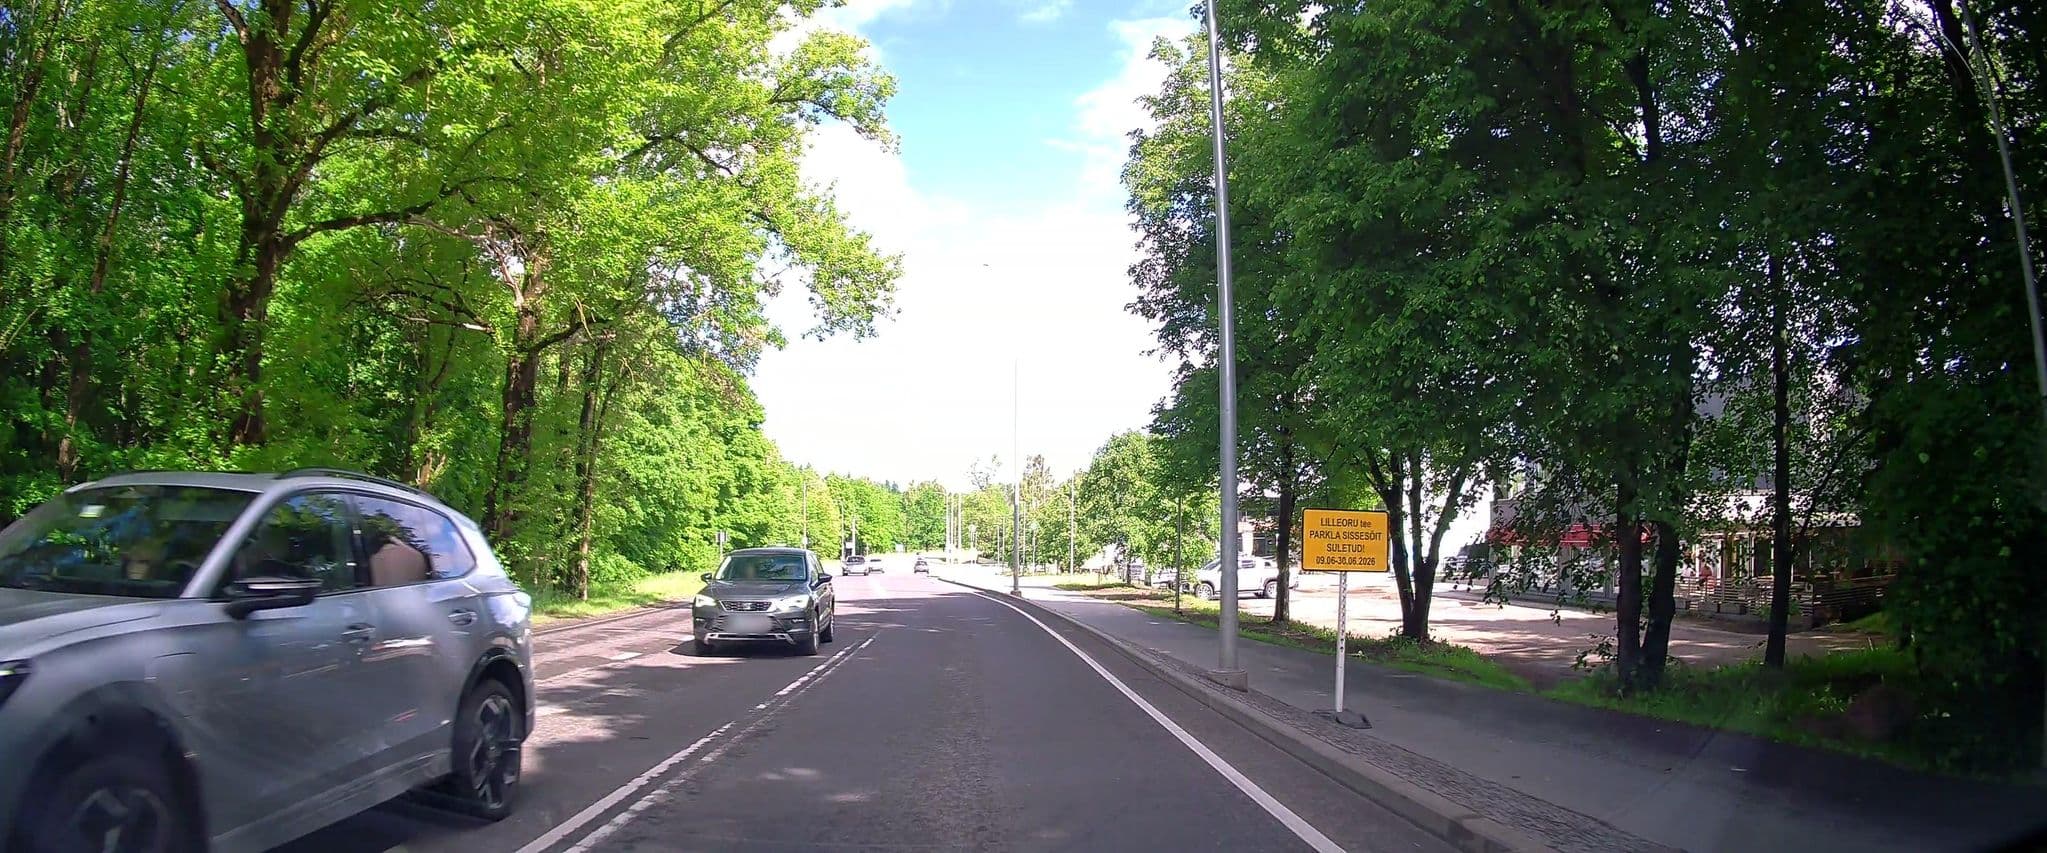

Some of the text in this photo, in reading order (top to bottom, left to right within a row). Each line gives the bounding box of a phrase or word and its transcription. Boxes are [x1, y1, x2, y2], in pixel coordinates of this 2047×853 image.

[1320, 518, 1372, 528] LILLEORU tee
[1309, 530, 1382, 540] PARKLA SISSESÕIT
[1326, 543, 1365, 553] SULETUD!
